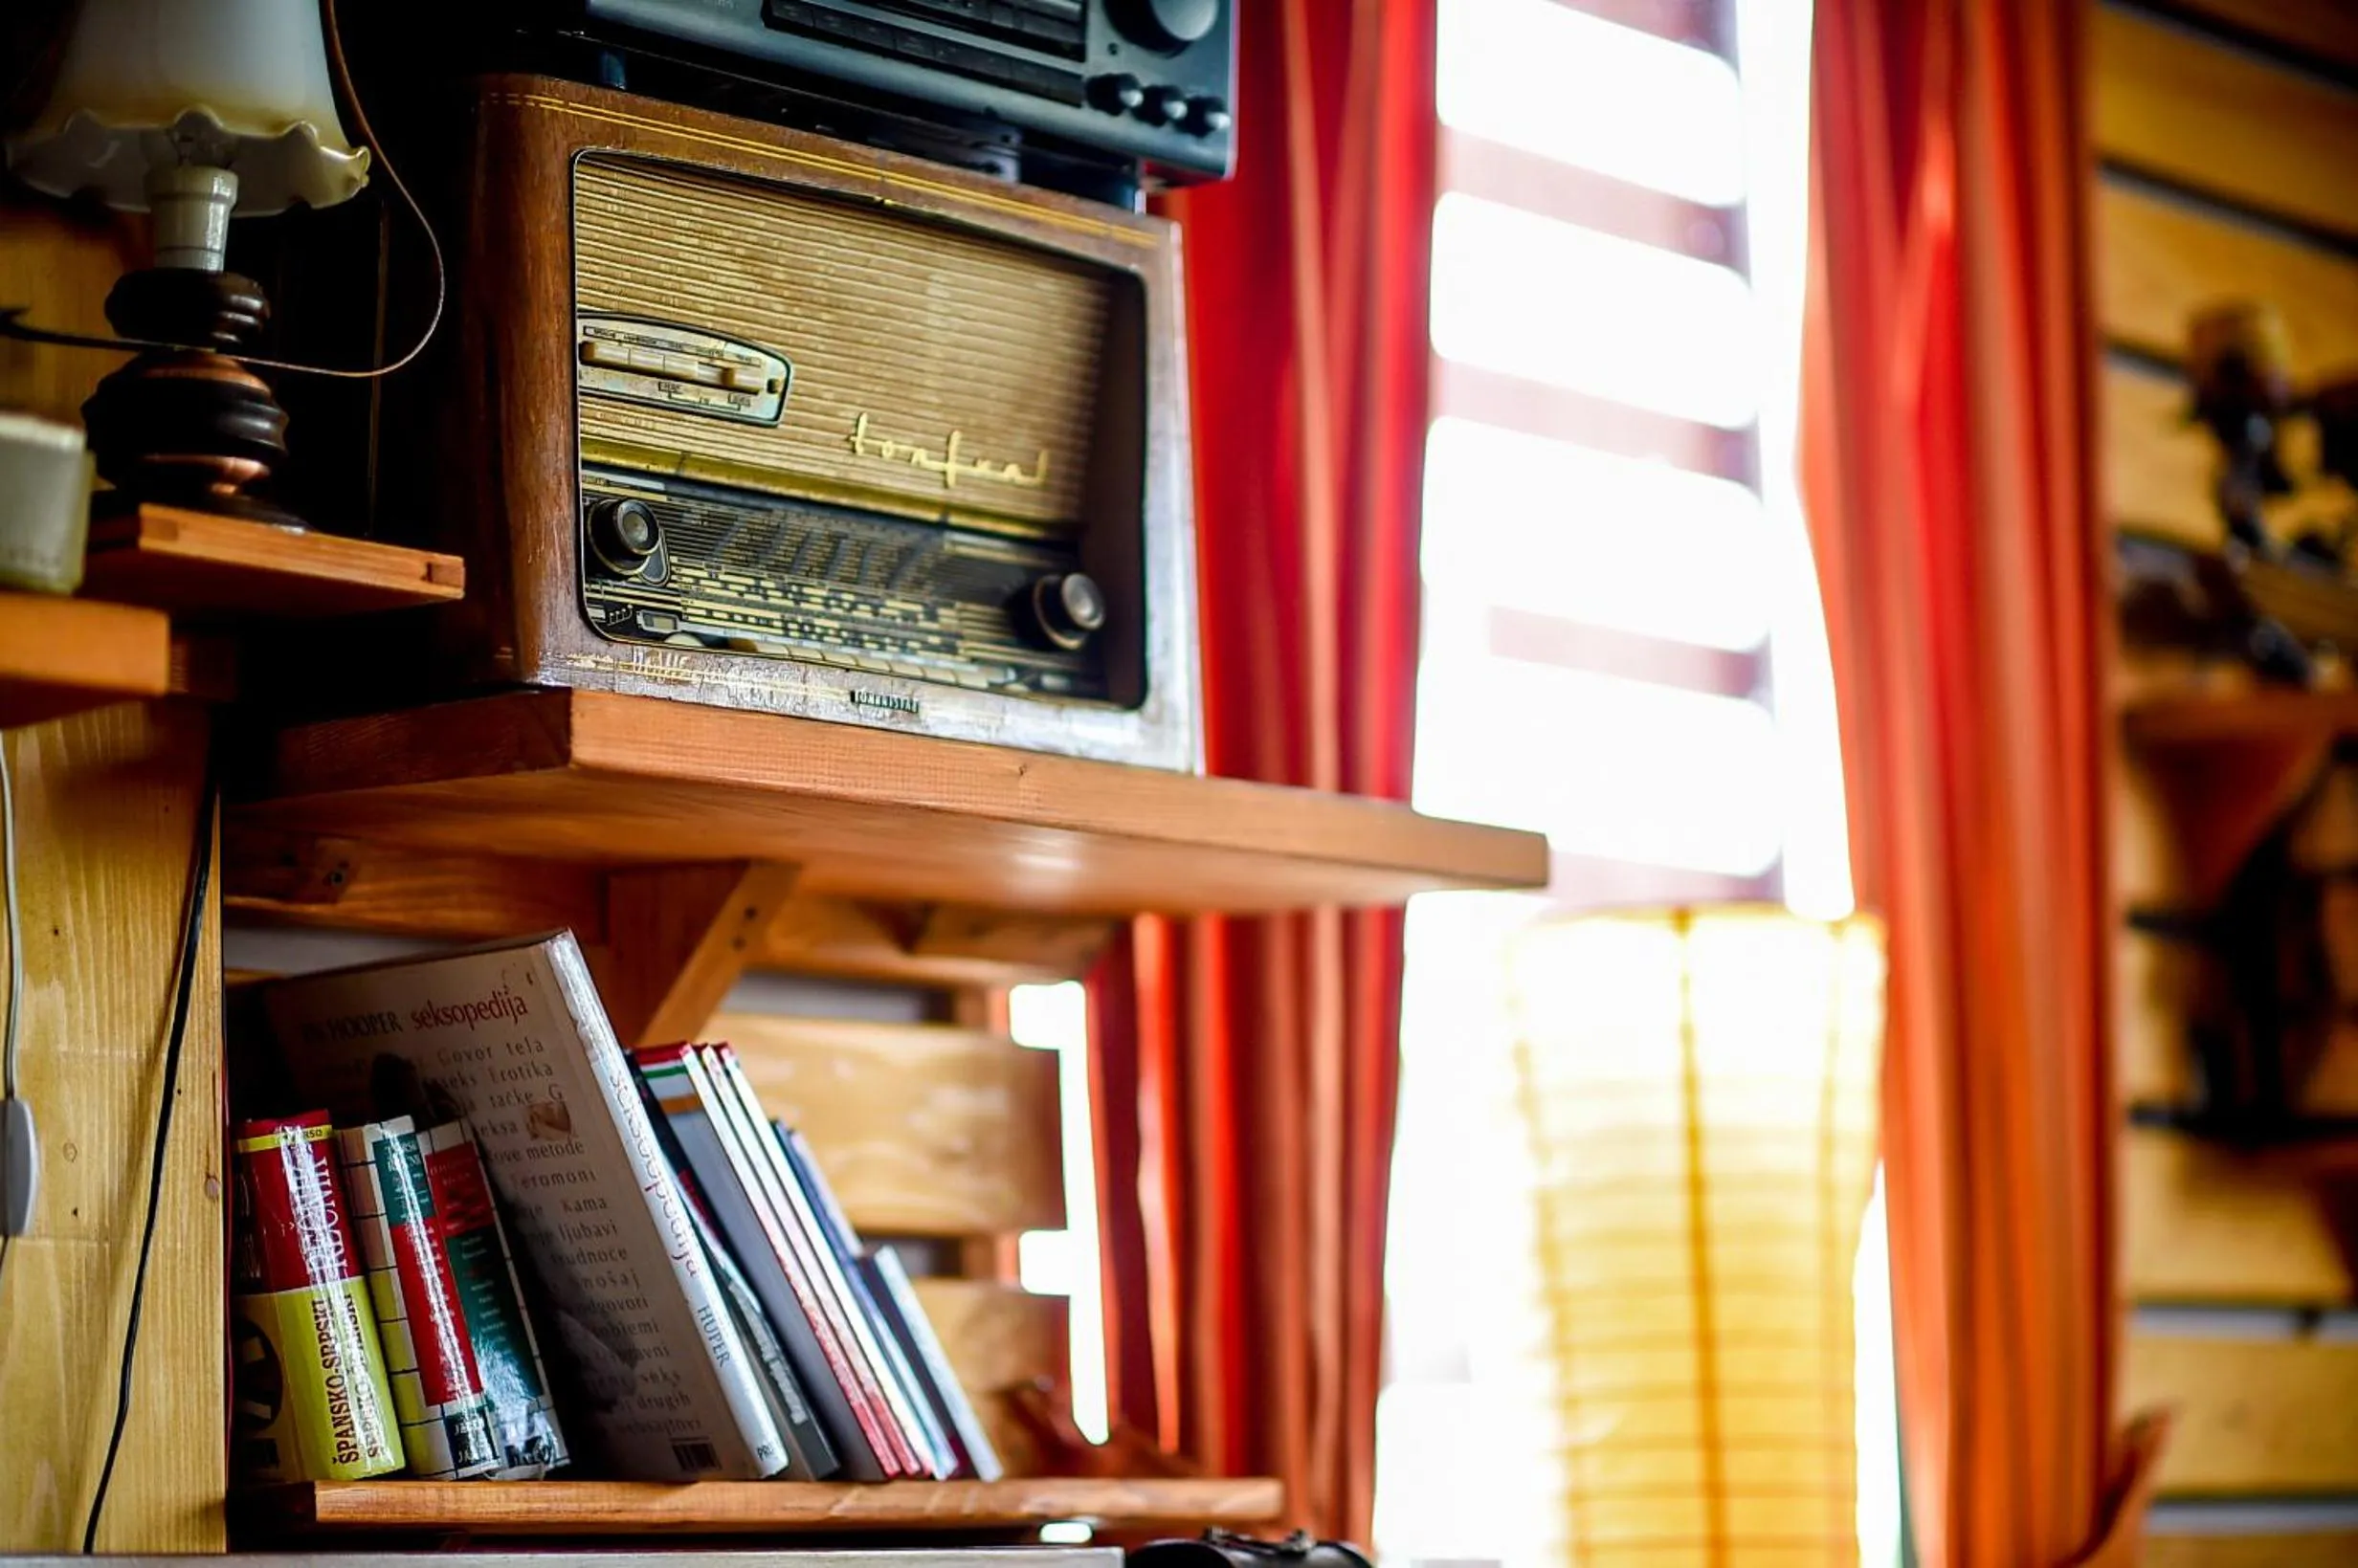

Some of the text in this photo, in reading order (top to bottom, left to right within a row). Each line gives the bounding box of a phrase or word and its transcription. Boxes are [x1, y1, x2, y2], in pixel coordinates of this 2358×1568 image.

[326, 1011, 403, 1041] HOOPER
[411, 989, 528, 1030] seksopedija
[437, 1036, 544, 1065] Govor tela
[488, 1061, 553, 1084] Erotika
[548, 1084, 564, 1101] G
[526, 1136, 584, 1159] metode
[561, 1197, 608, 1213] Kama
[559, 1219, 618, 1244] ljubavi
[698, 1305, 730, 1368] HUPER
[312, 1298, 360, 1465] ŠPANSKO-SRPSKI
